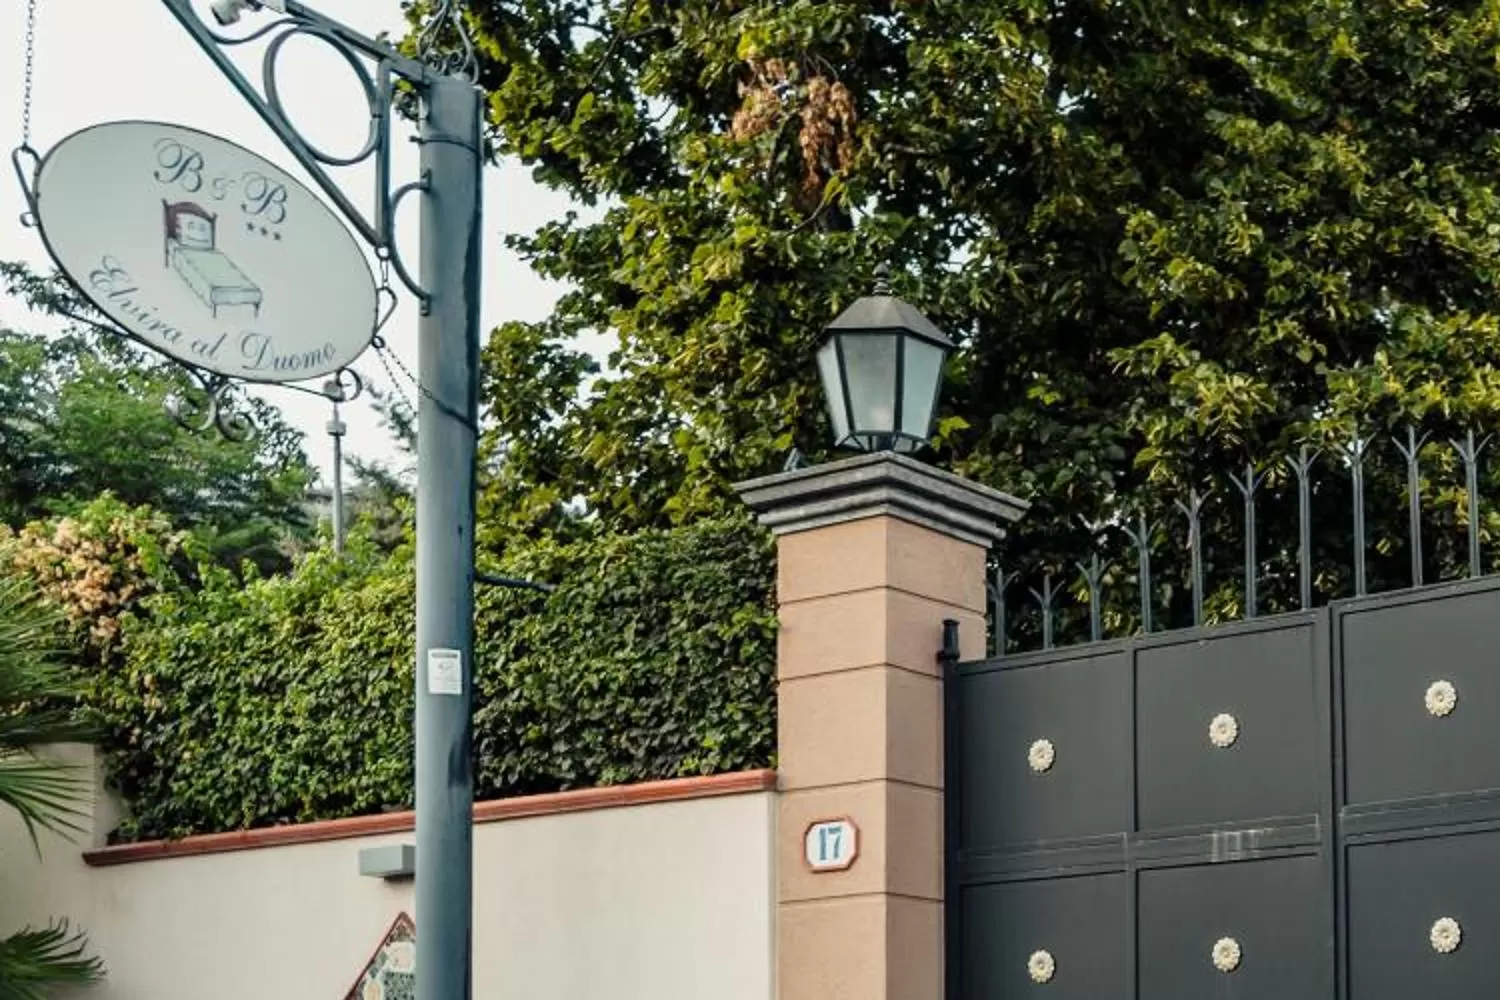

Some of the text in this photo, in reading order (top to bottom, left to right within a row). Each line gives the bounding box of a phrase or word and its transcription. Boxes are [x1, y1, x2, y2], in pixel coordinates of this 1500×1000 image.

[89, 254, 336, 371] Elvira al Duomo
[819, 827, 843, 861] 17
